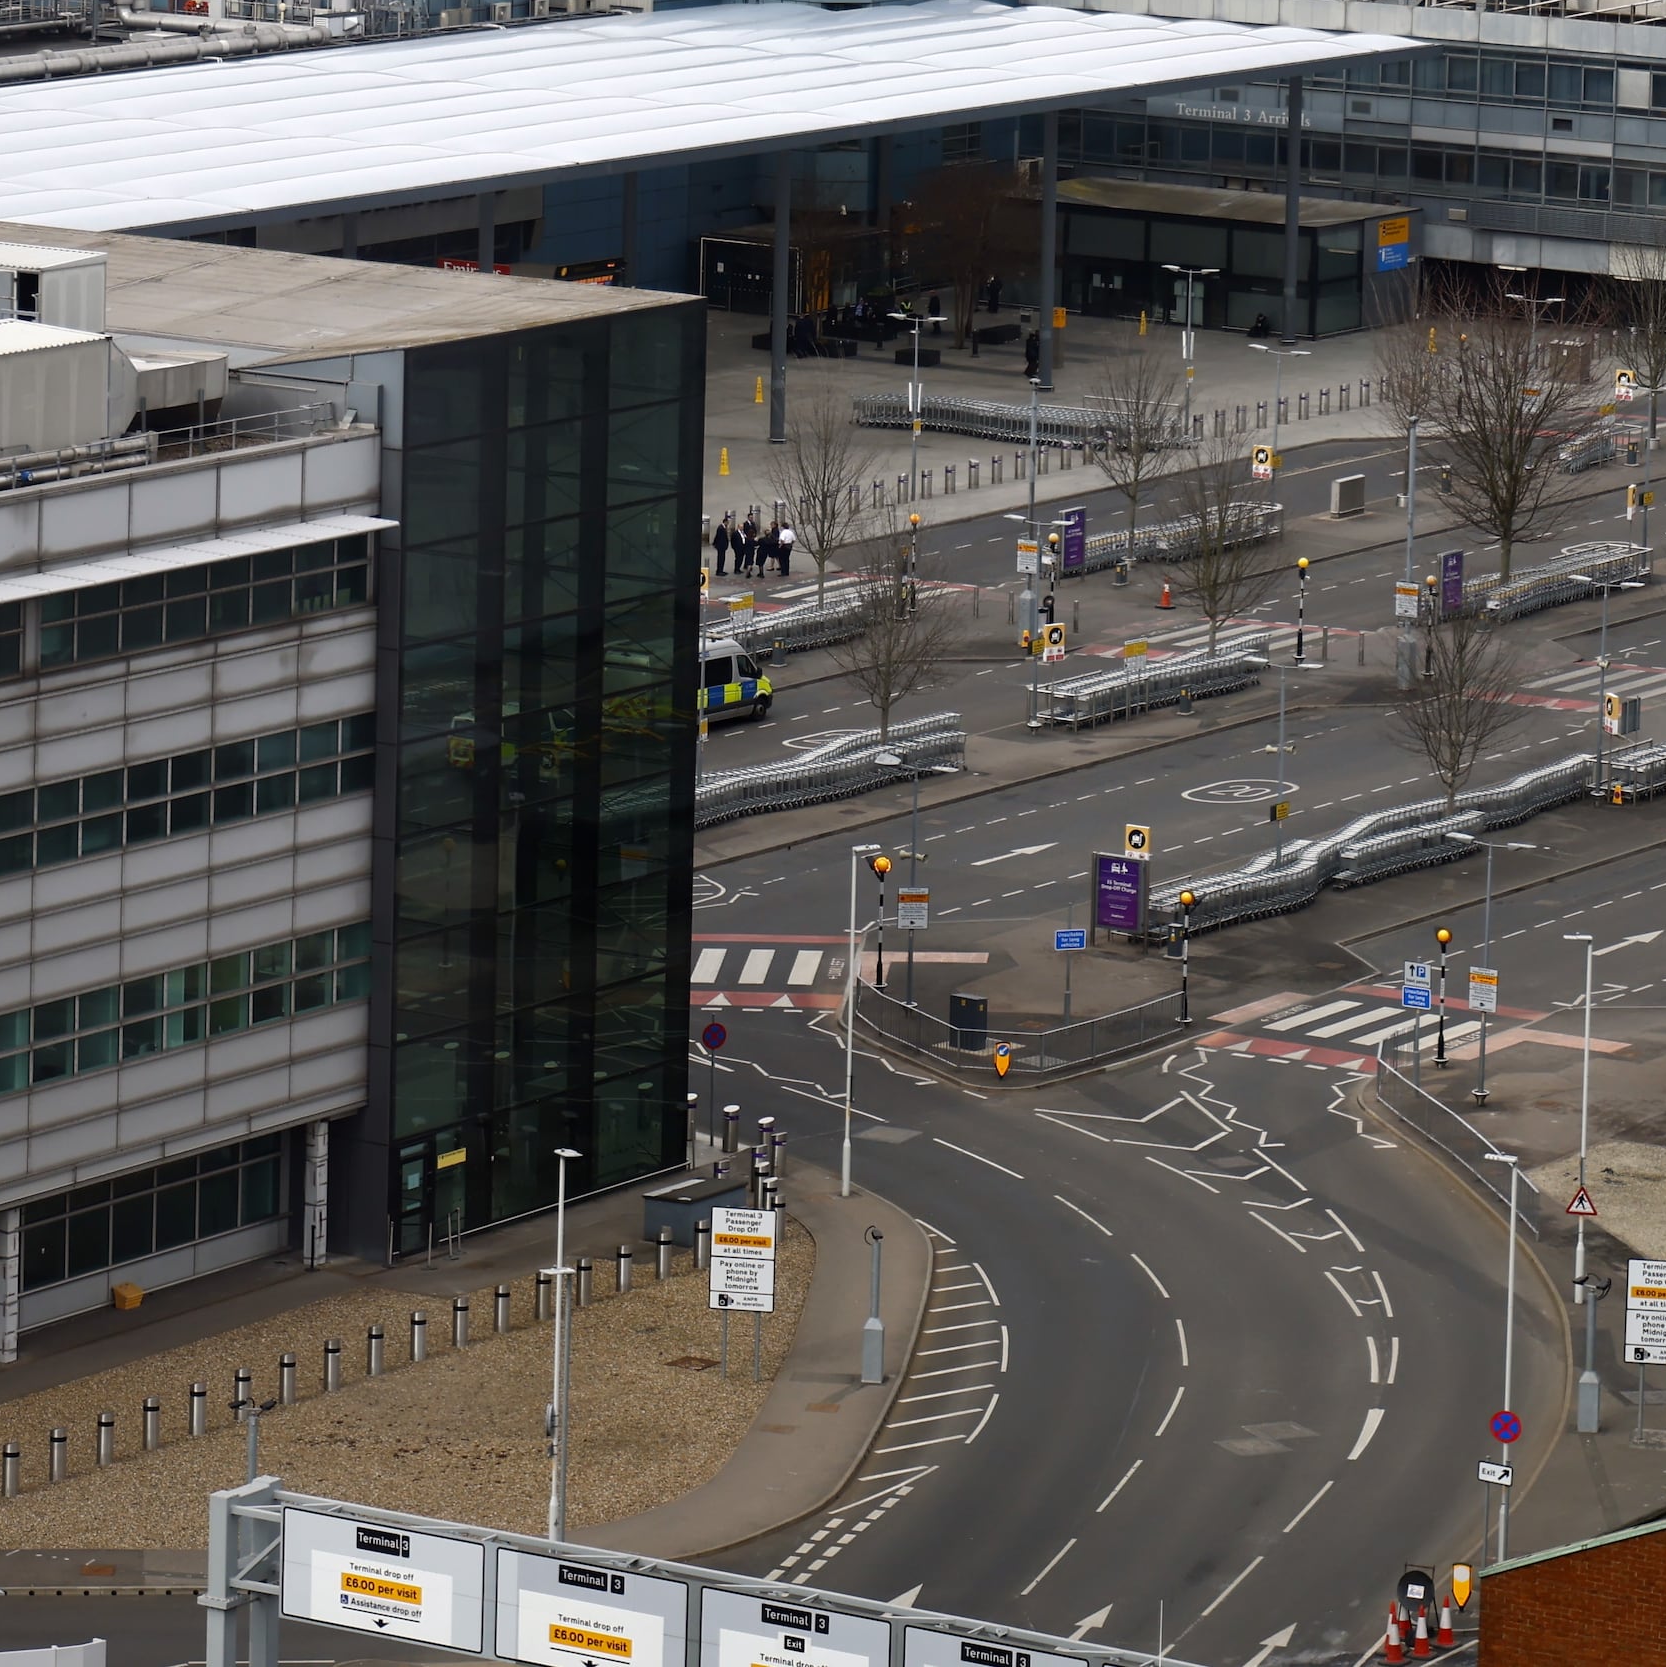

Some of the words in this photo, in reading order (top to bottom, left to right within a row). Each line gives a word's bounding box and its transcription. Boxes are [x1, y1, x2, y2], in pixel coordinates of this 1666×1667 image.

[1207, 784, 1271, 798] 20
[725, 1218, 762, 1226] Passenger
[726, 1211, 756, 1219] Terminal
[726, 1268, 748, 1276] phone
[726, 1275, 757, 1283] Midnight
[1636, 1289, 1656, 1297] £6.00
[1636, 1313, 1649, 1321] Pay
[1642, 1321, 1665, 1329] phone
[1482, 1467, 1496, 1478] Exit
[358, 1531, 400, 1551] Terminal
[402, 1540, 409, 1552] 3
[349, 1562, 382, 1577] Terminal
[384, 1568, 402, 1581] drop
[403, 1572, 414, 1581] off
[561, 1569, 605, 1587] Terminal
[614, 1579, 621, 1590] 3
[345, 1577, 375, 1592] £6.00
[378, 1585, 394, 1596] per
[396, 1587, 417, 1600] visit
[350, 1597, 389, 1612] Assistance
[390, 1604, 408, 1618] drop
[410, 1608, 422, 1618] off
[558, 1613, 591, 1628] Terminal
[593, 1619, 611, 1633] drop
[613, 1623, 624, 1633] off
[764, 1608, 809, 1626] Terminal
[818, 1618, 826, 1630] 3
[554, 1629, 584, 1644] £6.00
[587, 1636, 604, 1648] per
[606, 1637, 628, 1652] visit
[786, 1639, 802, 1649] Exit
[760, 1653, 793, 1667] Terminal
[964, 1646, 1009, 1665] Terminal
[1019, 1657, 1027, 1667] 3
